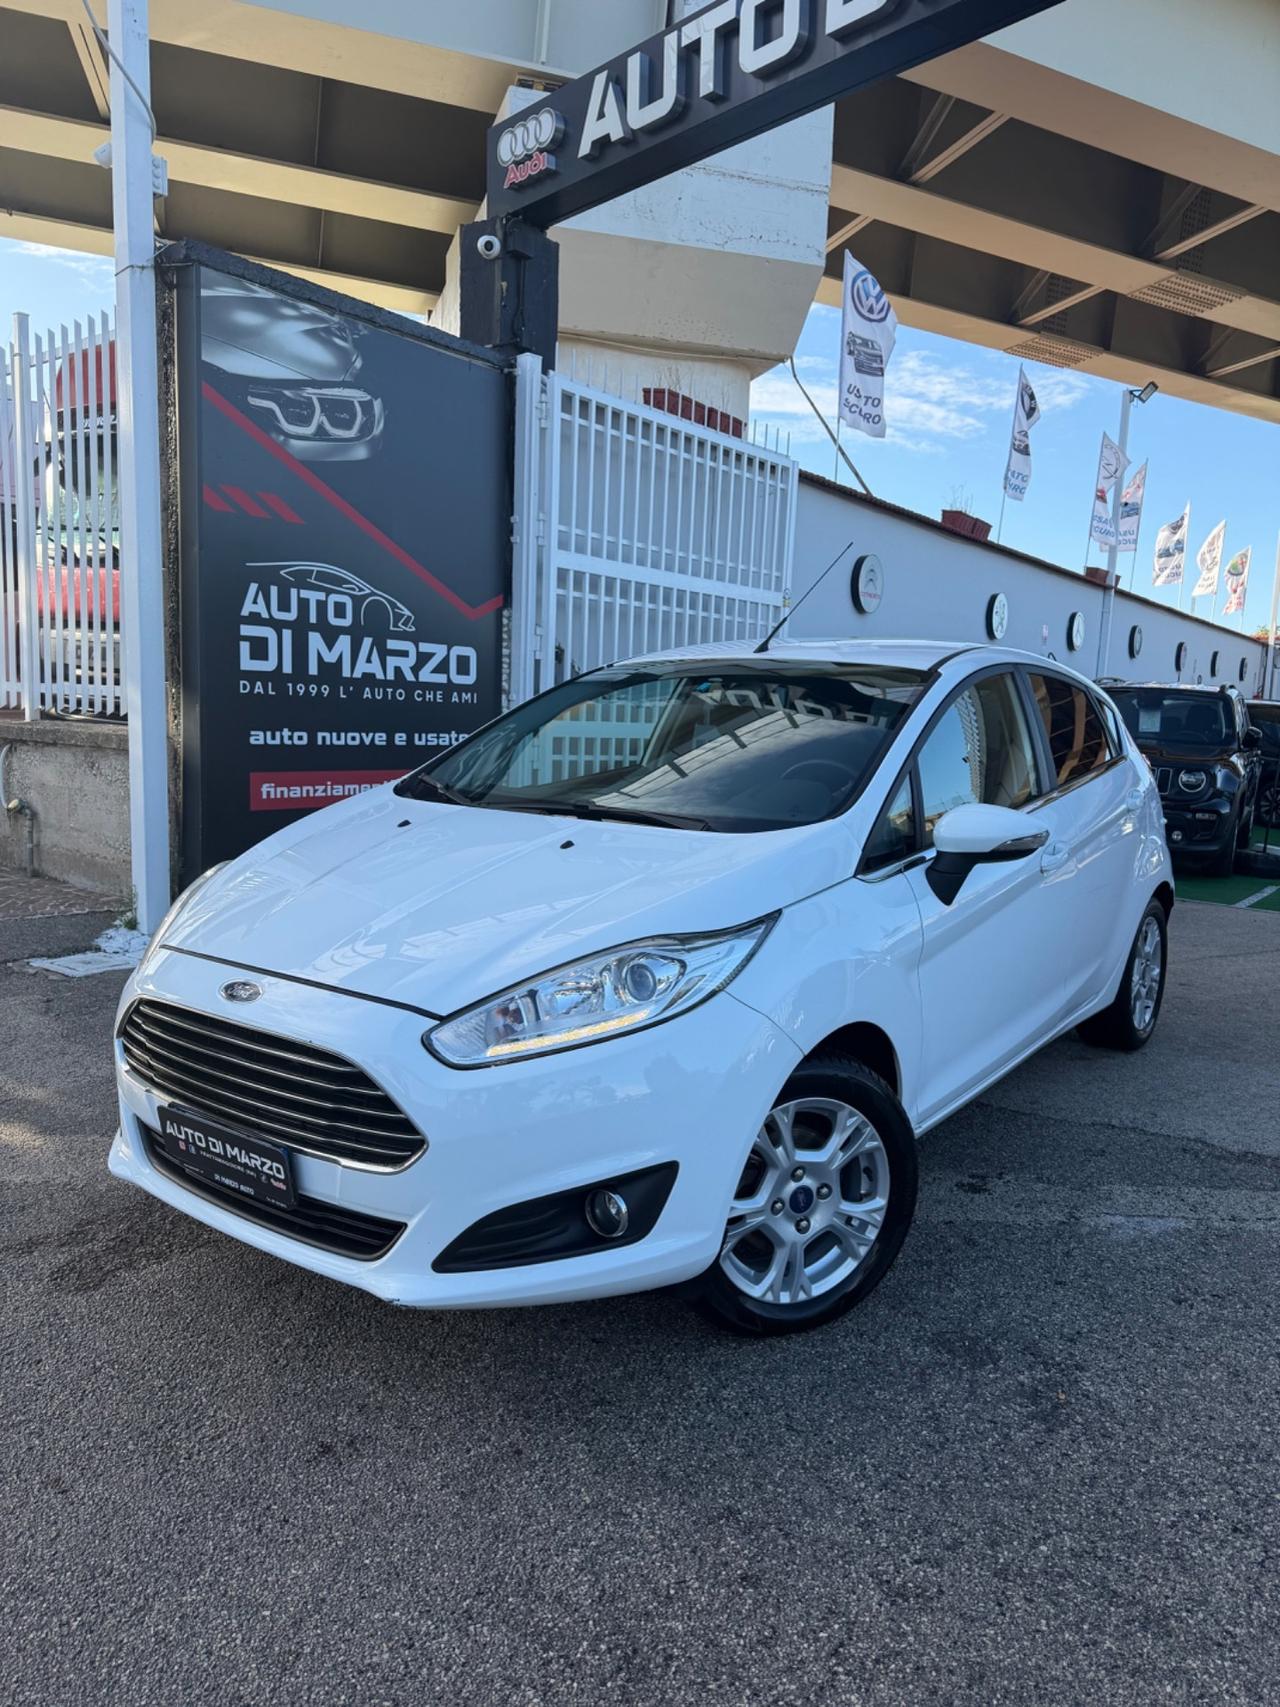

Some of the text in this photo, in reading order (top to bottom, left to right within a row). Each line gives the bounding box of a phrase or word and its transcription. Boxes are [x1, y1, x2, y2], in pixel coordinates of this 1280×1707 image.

[577, 0, 800, 159] AUTO
[504, 151, 547, 189] Audi
[240, 582, 353, 627] AUTO
[239, 624, 477, 685] DI MARZO
[239, 680, 276, 695] DAL
[287, 683, 330, 697] 1999
[363, 687, 406, 701] AUTO
[414, 689, 444, 703] CHE
[451, 691, 478, 704] AMI
[249, 727, 308, 746] auto
[317, 731, 387, 746] nuove
[394, 732, 407, 746] e
[166, 1120, 206, 1148] AUTO
[208, 1138, 224, 1155] DI
[226, 1143, 285, 1180] MARZO
